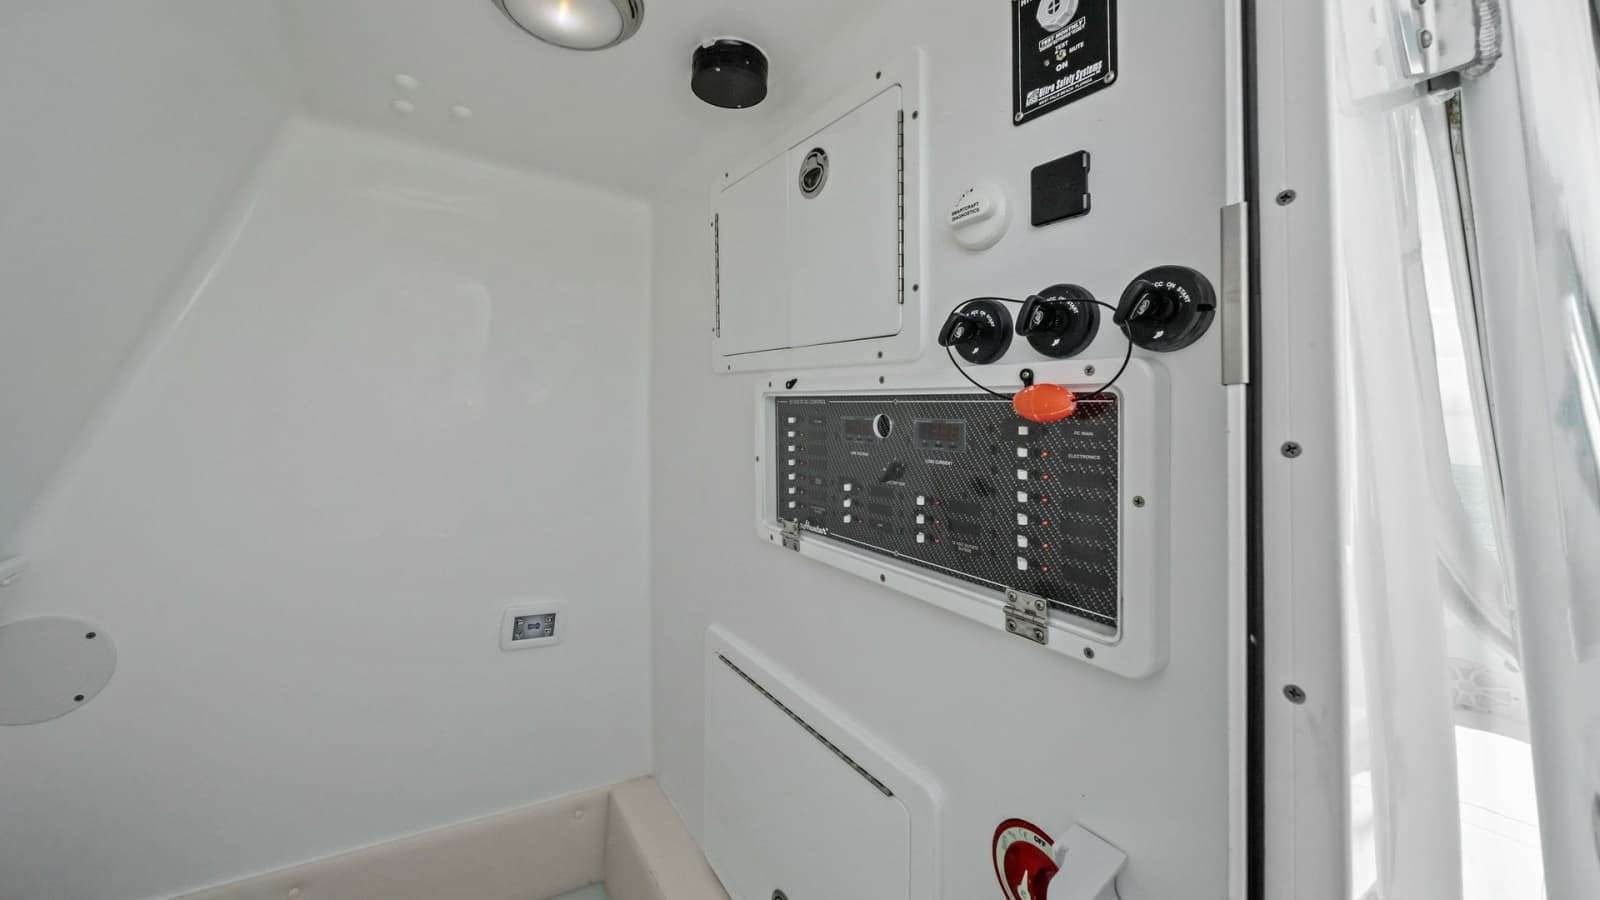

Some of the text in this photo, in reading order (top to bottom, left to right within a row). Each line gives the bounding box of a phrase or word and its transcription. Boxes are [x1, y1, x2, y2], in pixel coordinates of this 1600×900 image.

[1041, 35, 1054, 47] TEST
[1055, 21, 1083, 38] MONTHLY
[1055, 40, 1069, 51] TEST
[1069, 41, 1084, 53] MUTE
[1056, 60, 1069, 72] ON
[1056, 74, 1075, 90] Safety
[1075, 60, 1103, 81] Systems
[952, 201, 979, 216] SMARTCRAFT
[952, 207, 980, 222] DIAGNOSTICS
[1176, 286, 1191, 302] START
[1033, 835, 1047, 847] OFF
